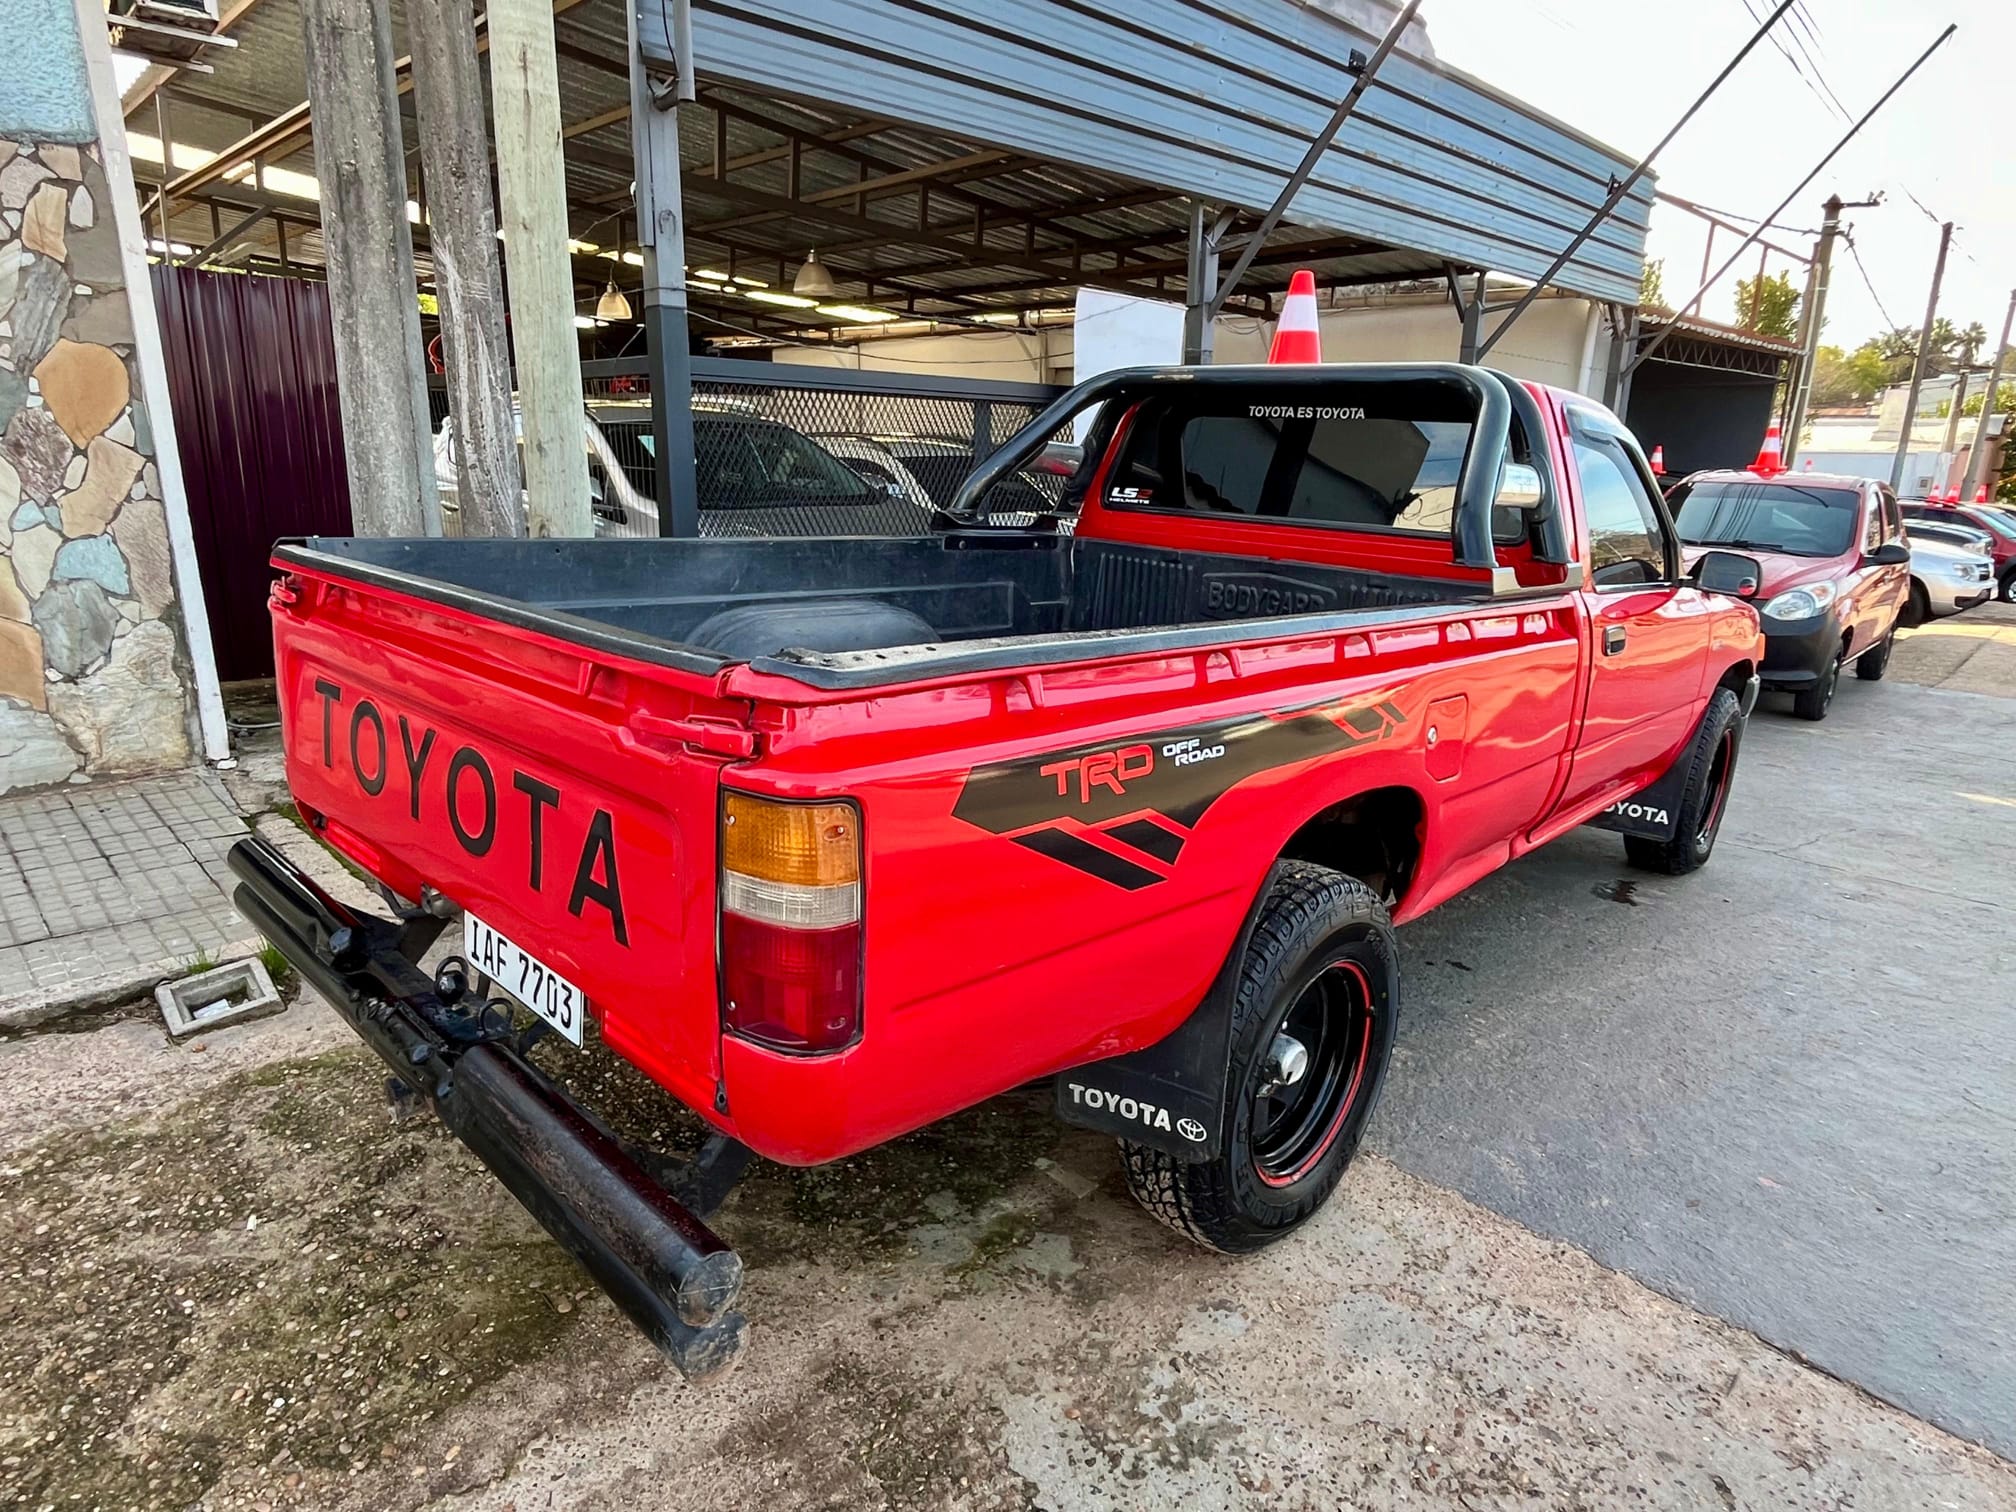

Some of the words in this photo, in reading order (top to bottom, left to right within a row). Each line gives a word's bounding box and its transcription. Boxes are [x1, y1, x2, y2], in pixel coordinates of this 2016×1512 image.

[1249, 405, 1294, 418] TOYOTA
[1297, 406, 1313, 418] ES
[1315, 407, 1365, 419] TOYOTA
[1162, 738, 1201, 758] OFF
[1174, 745, 1225, 767] ROAD
[1039, 744, 1154, 804] TRD
[314, 674, 632, 949] TOYOTA
[1602, 801, 1669, 825] YOTA
[471, 919, 508, 977] IAF
[518, 951, 573, 1030] 7703
[1068, 1083, 1172, 1132] TOYOTA
